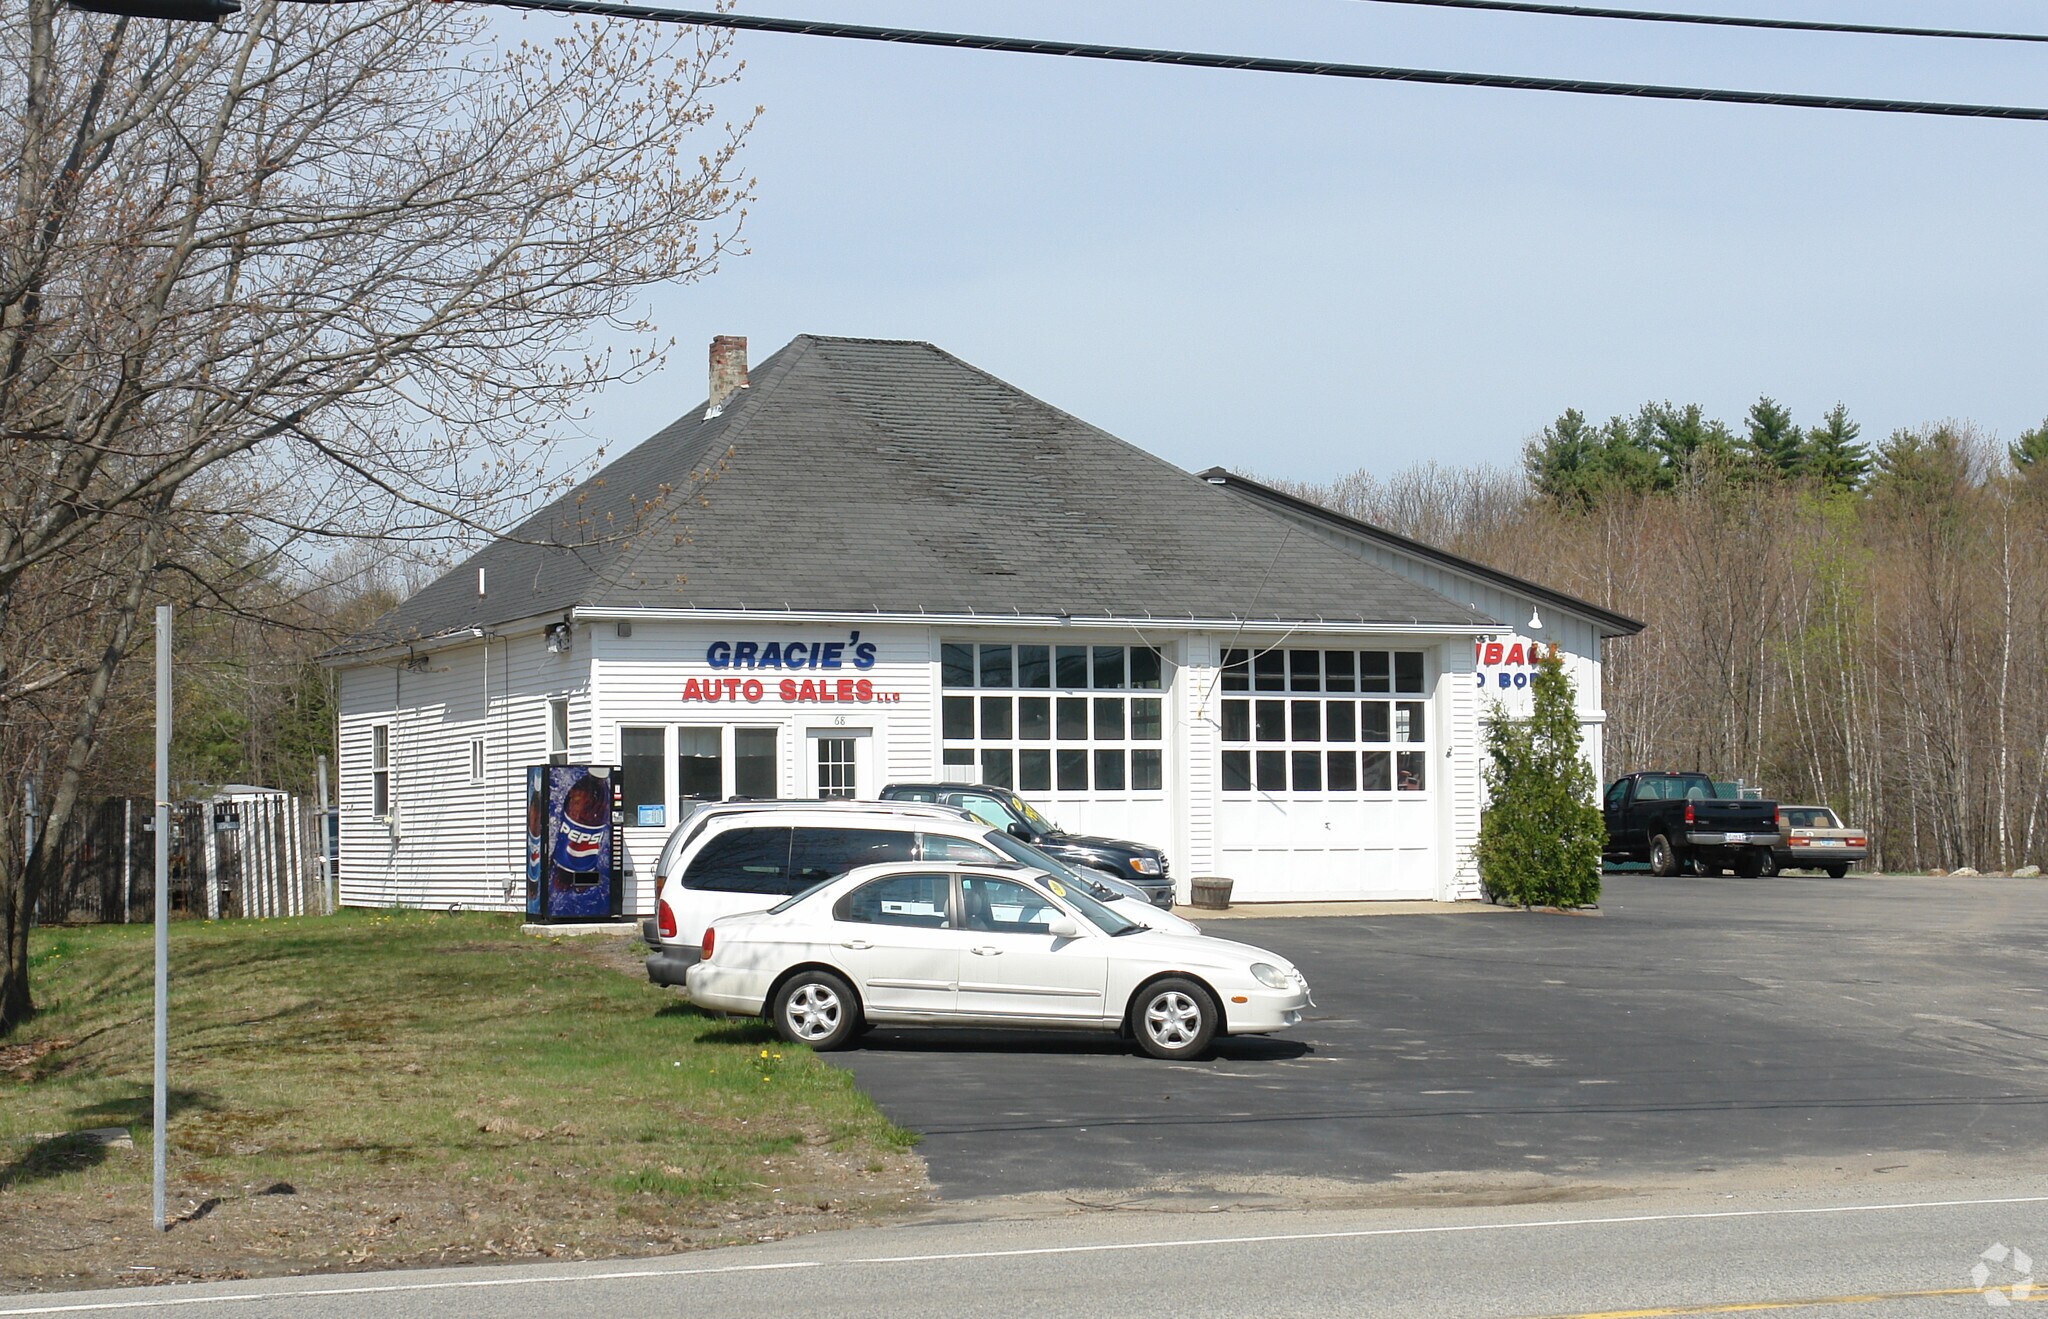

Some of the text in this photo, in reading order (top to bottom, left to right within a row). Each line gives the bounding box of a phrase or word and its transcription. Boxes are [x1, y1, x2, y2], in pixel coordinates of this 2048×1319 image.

[707, 631, 876, 670] GRACIE'S
[682, 679, 764, 702] AUTO
[779, 679, 873, 703] SALES
[834, 715, 846, 726] 68
[560, 821, 603, 845] PEPSI
